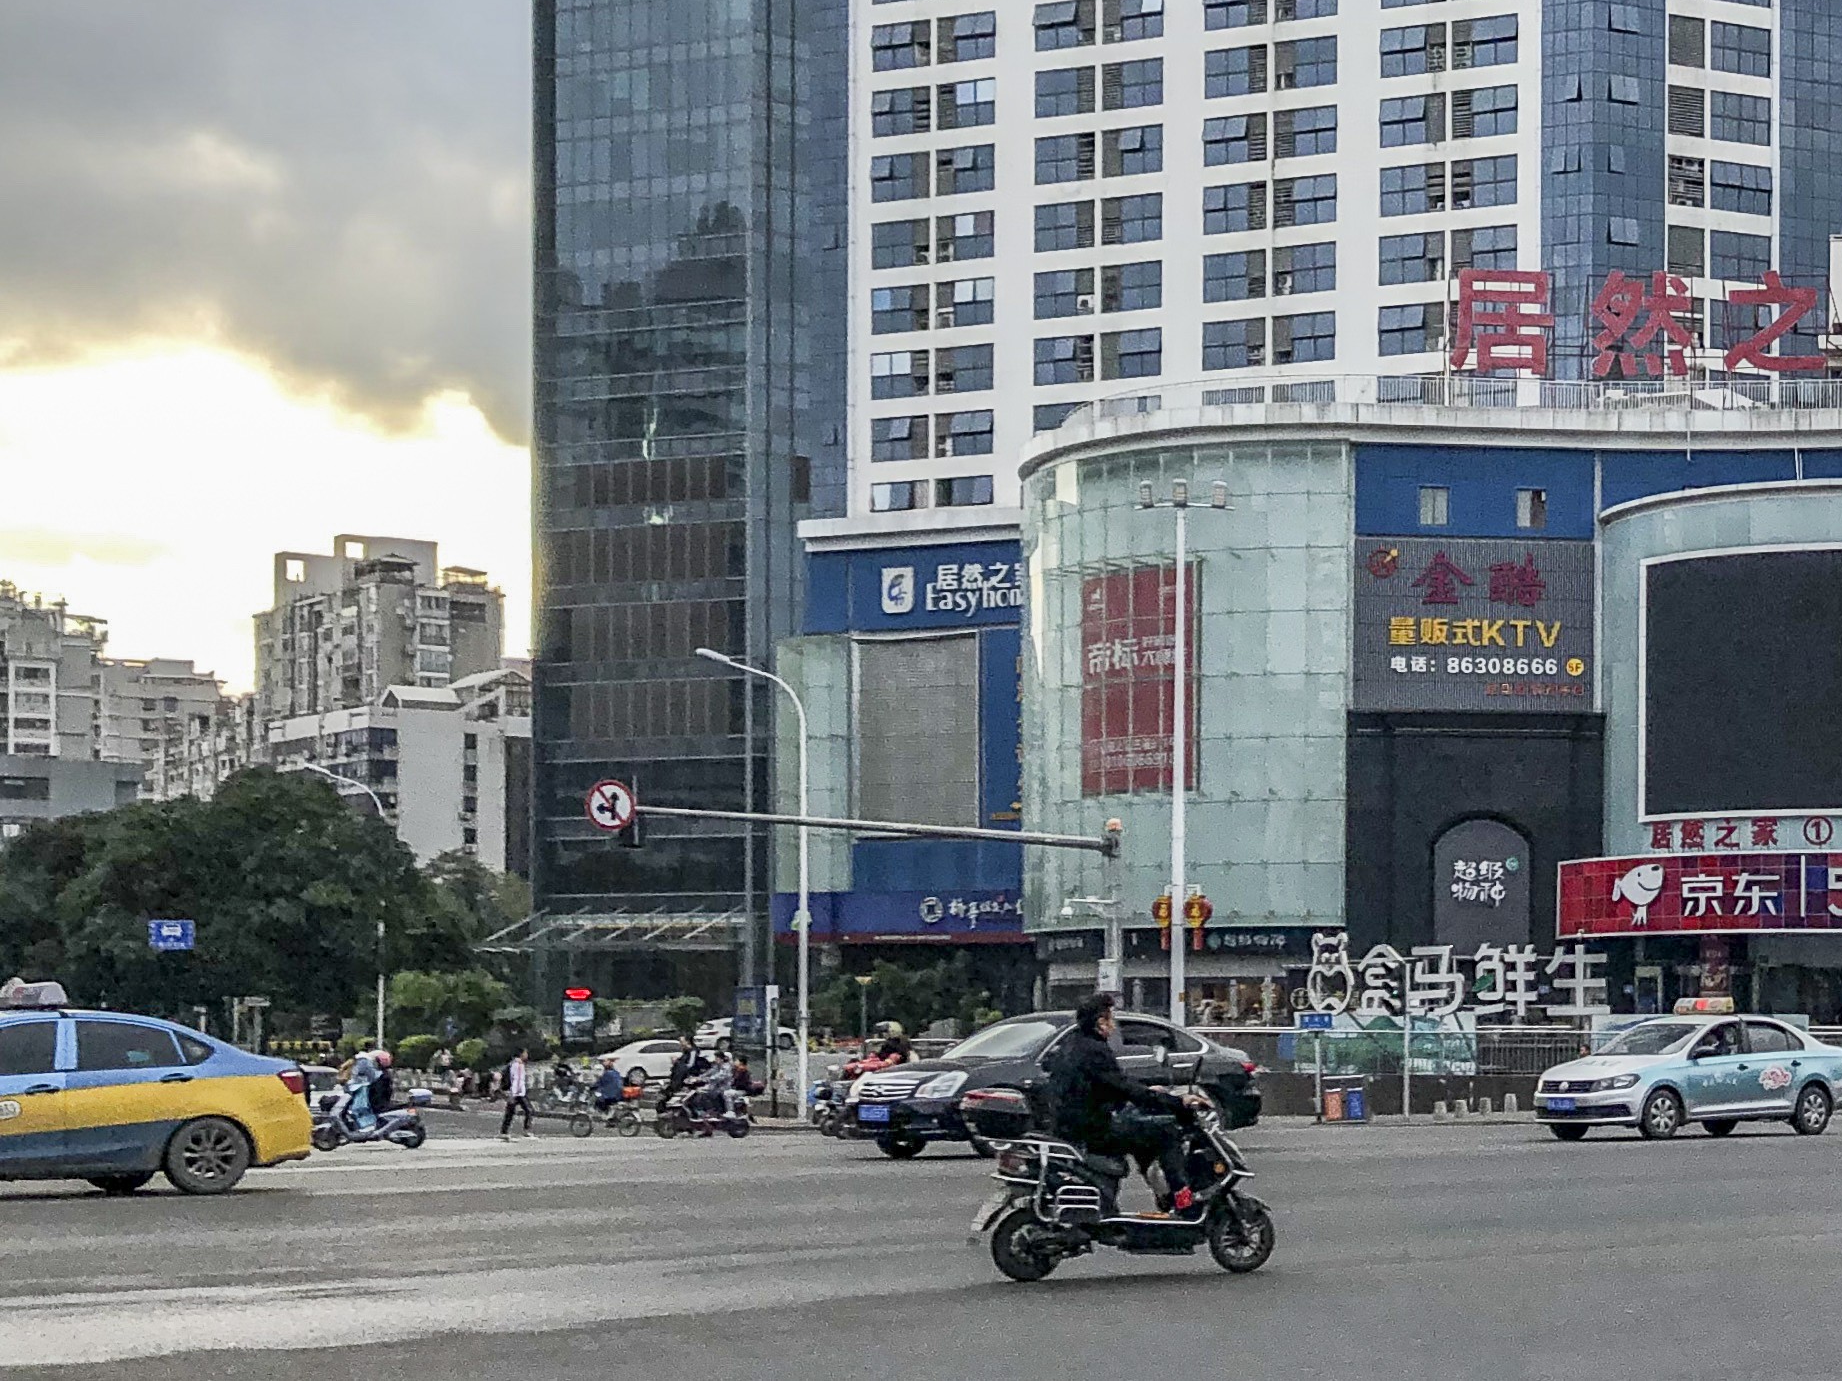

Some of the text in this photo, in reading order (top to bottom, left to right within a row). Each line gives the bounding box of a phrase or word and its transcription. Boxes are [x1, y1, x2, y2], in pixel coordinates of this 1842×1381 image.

[1411, 550, 1547, 607] 金酷
[1388, 616, 1562, 649] 量贩式KTV
[1390, 656, 1437, 673] 电话：
[1446, 657, 1558, 675] 86308666
[1651, 818, 1779, 849] 居然之家
[1453, 859, 1505, 881] 超级
[1451, 880, 1506, 907] 物种
[1681, 873, 1780, 917] 京东
[1357, 943, 1611, 1017] 盒马鲜生
